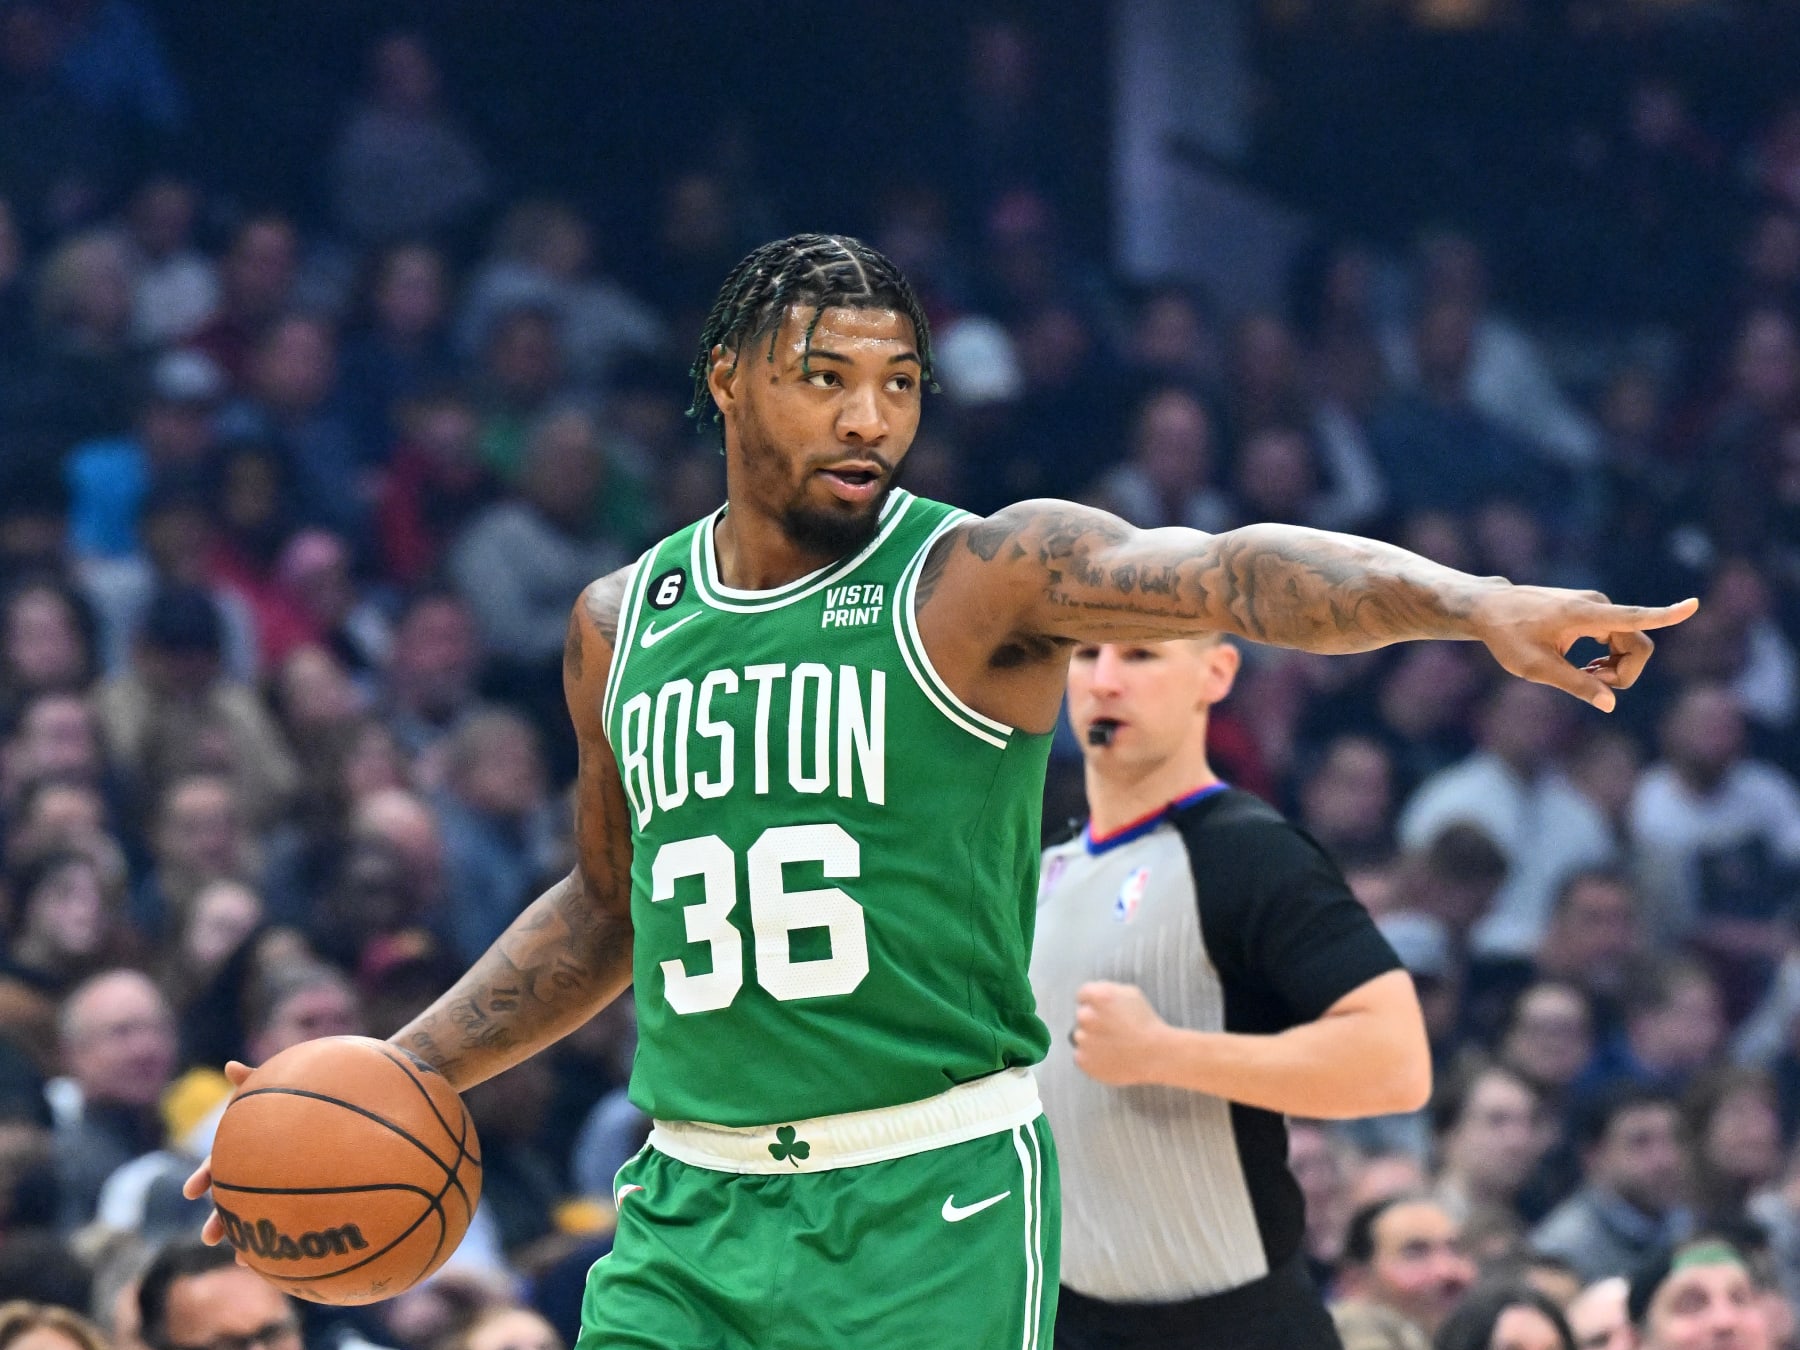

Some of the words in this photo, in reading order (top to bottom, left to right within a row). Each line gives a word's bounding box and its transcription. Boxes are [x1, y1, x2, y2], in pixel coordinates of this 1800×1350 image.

[655, 574, 682, 605] 6
[826, 584, 884, 609] VISTA
[821, 606, 883, 628] PRINT
[621, 662, 885, 832] BOSTON
[651, 823, 870, 1015] 36
